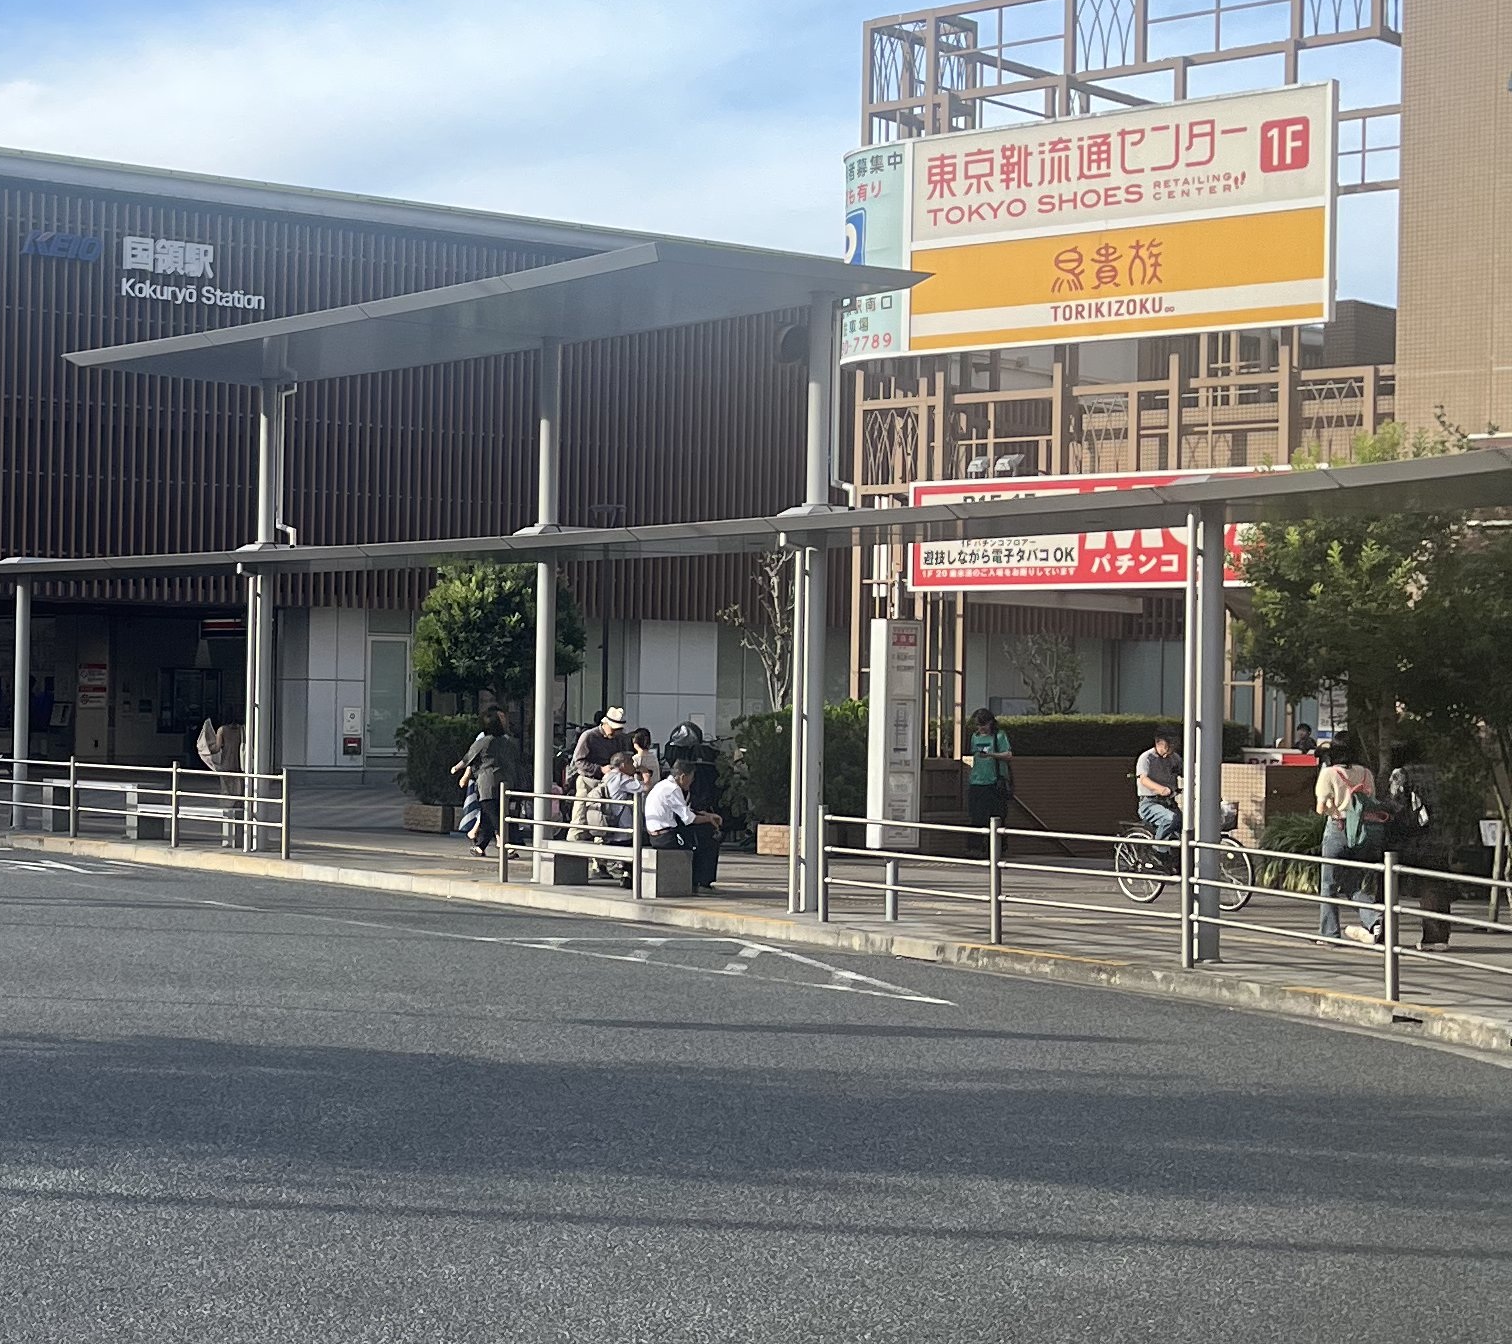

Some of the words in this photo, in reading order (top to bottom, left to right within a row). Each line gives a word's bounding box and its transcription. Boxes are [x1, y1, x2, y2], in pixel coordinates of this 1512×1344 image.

[926, 118, 1248, 201] 東京靴流通センター
[1266, 123, 1305, 167] 1F
[1152, 171, 1233, 190] RETAILING
[1152, 183, 1232, 201] CENTER
[926, 198, 1028, 227] TOKYO
[1037, 183, 1144, 215] SHOES
[21, 230, 104, 262] KEIO
[123, 235, 215, 279] 国領駅
[1050, 238, 1164, 293] 鳥貴族
[201, 285, 265, 311] Station
[1050, 296, 1163, 323] TORIKIZOKU
[1053, 546, 1076, 563] OK
[1090, 552, 1180, 576] パチンコ
